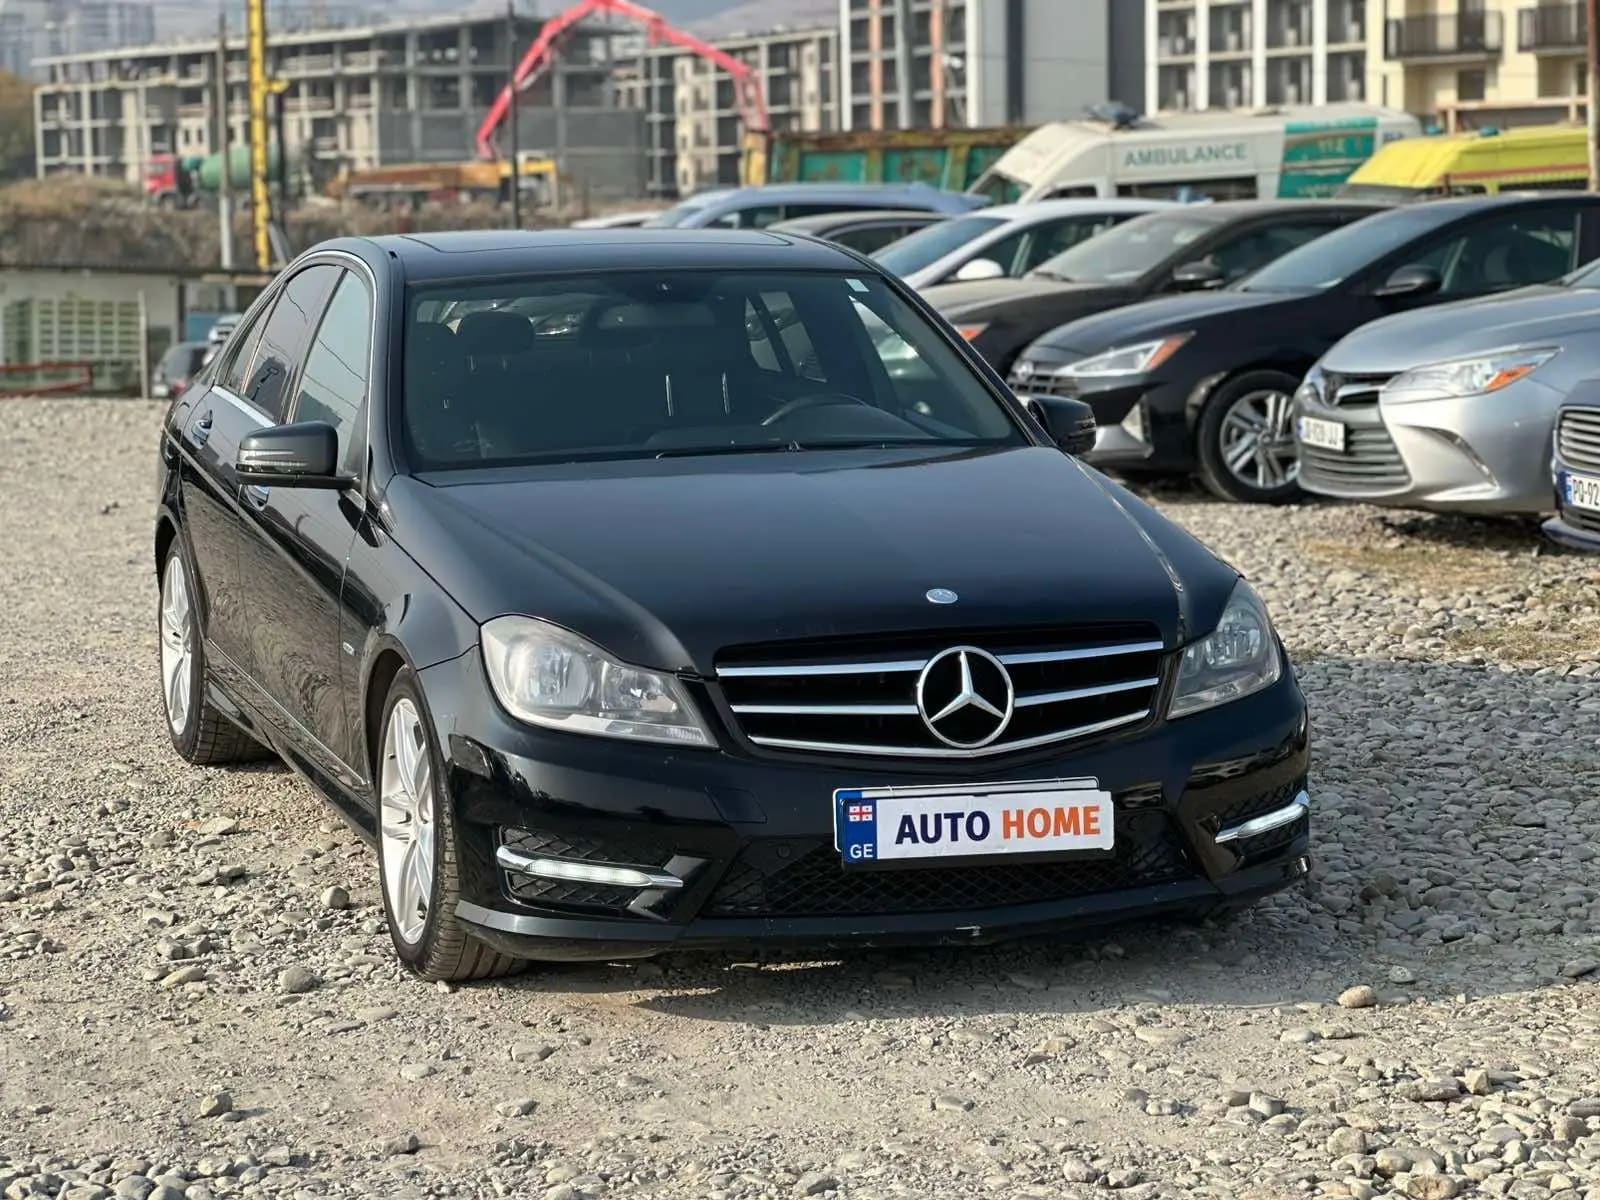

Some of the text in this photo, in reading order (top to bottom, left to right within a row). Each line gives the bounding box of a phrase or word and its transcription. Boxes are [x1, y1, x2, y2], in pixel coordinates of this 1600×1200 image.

[1125, 143, 1246, 166] AMBULANCE
[895, 806, 1101, 844] AUTO HOME
[850, 843, 873, 859] GE
